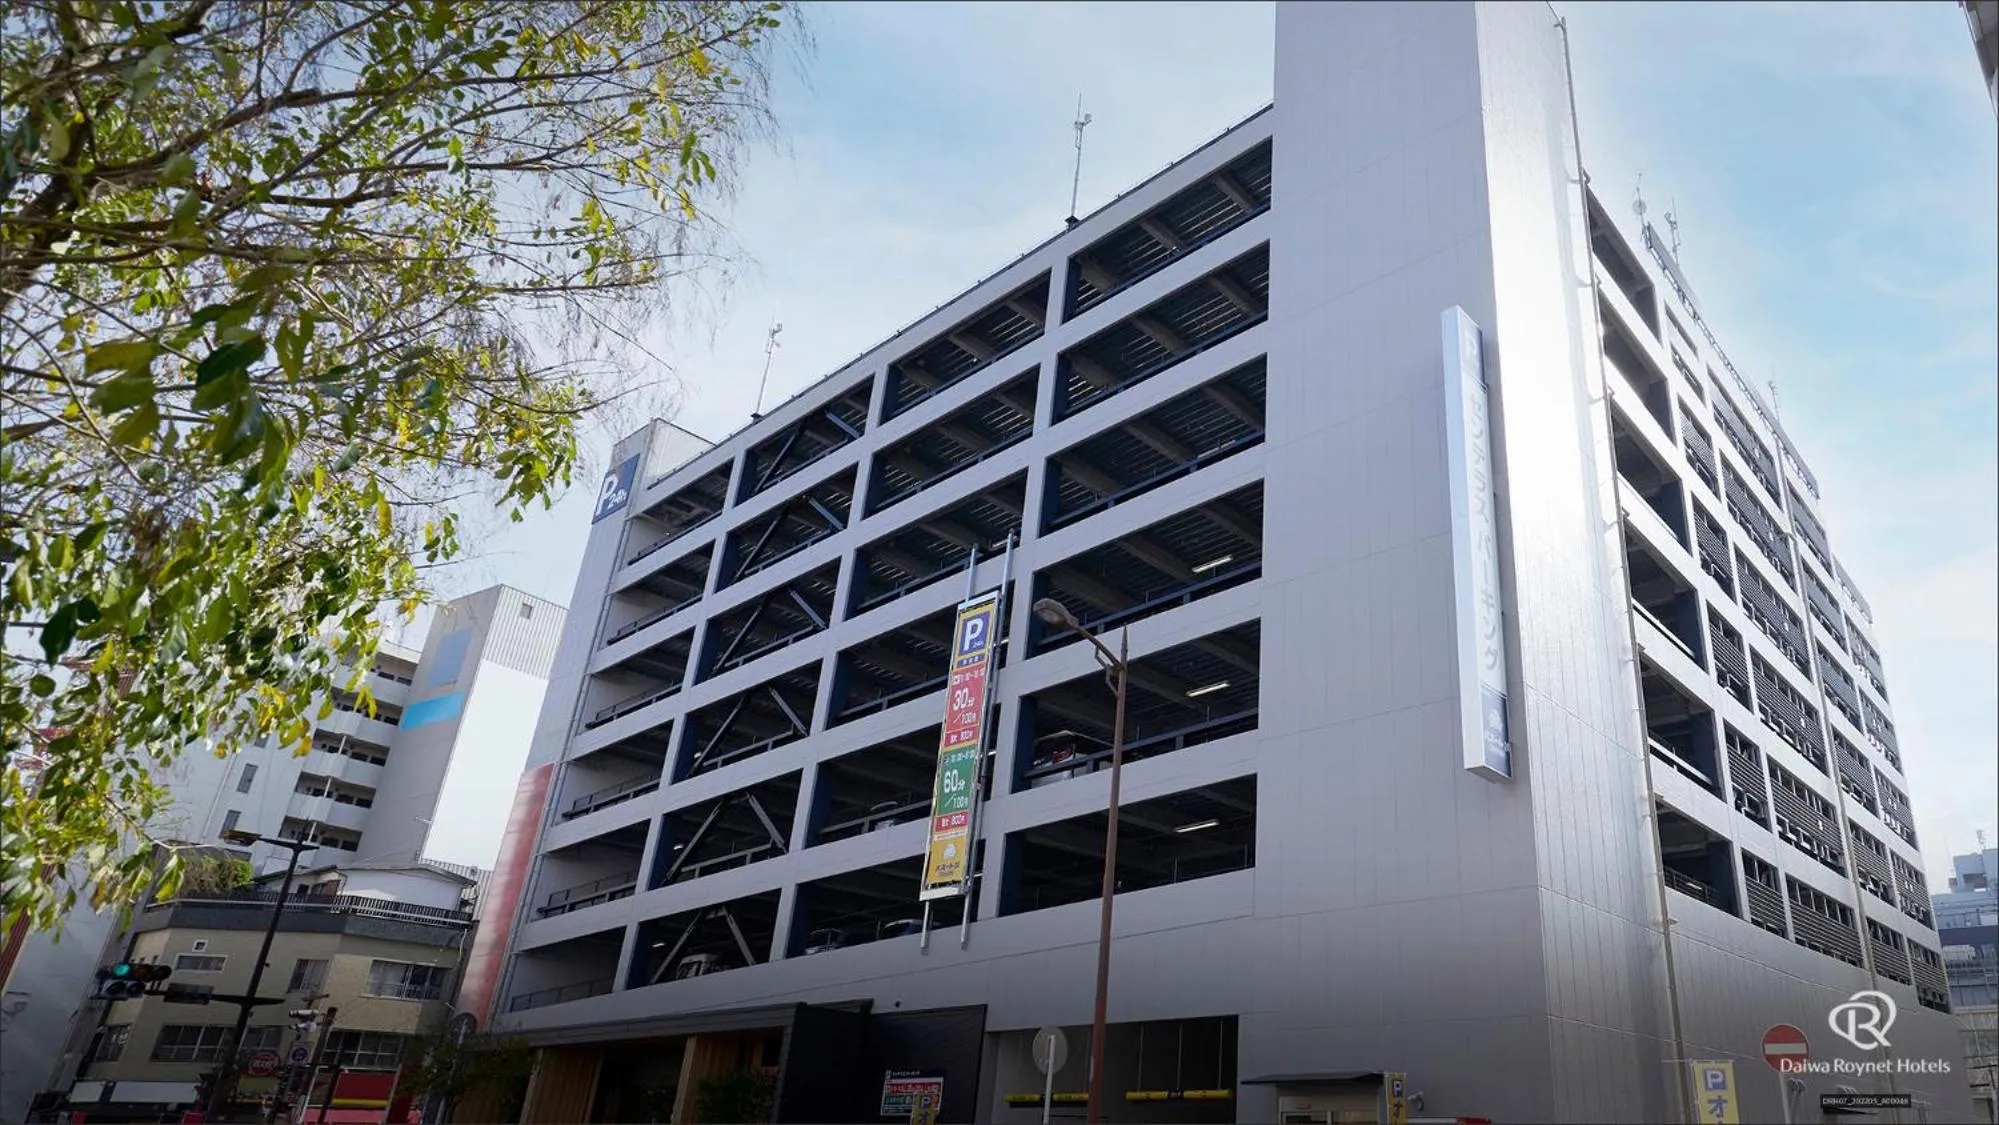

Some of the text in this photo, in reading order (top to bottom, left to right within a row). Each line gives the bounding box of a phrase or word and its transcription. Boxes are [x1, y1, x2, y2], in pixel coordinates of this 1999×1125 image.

[1466, 331, 1478, 358] P
[595, 473, 619, 517] P
[1470, 391, 1498, 671] センテラスパーキング
[963, 617, 984, 651] P
[1393, 1080, 1402, 1098] P
[1705, 1070, 1724, 1089] P
